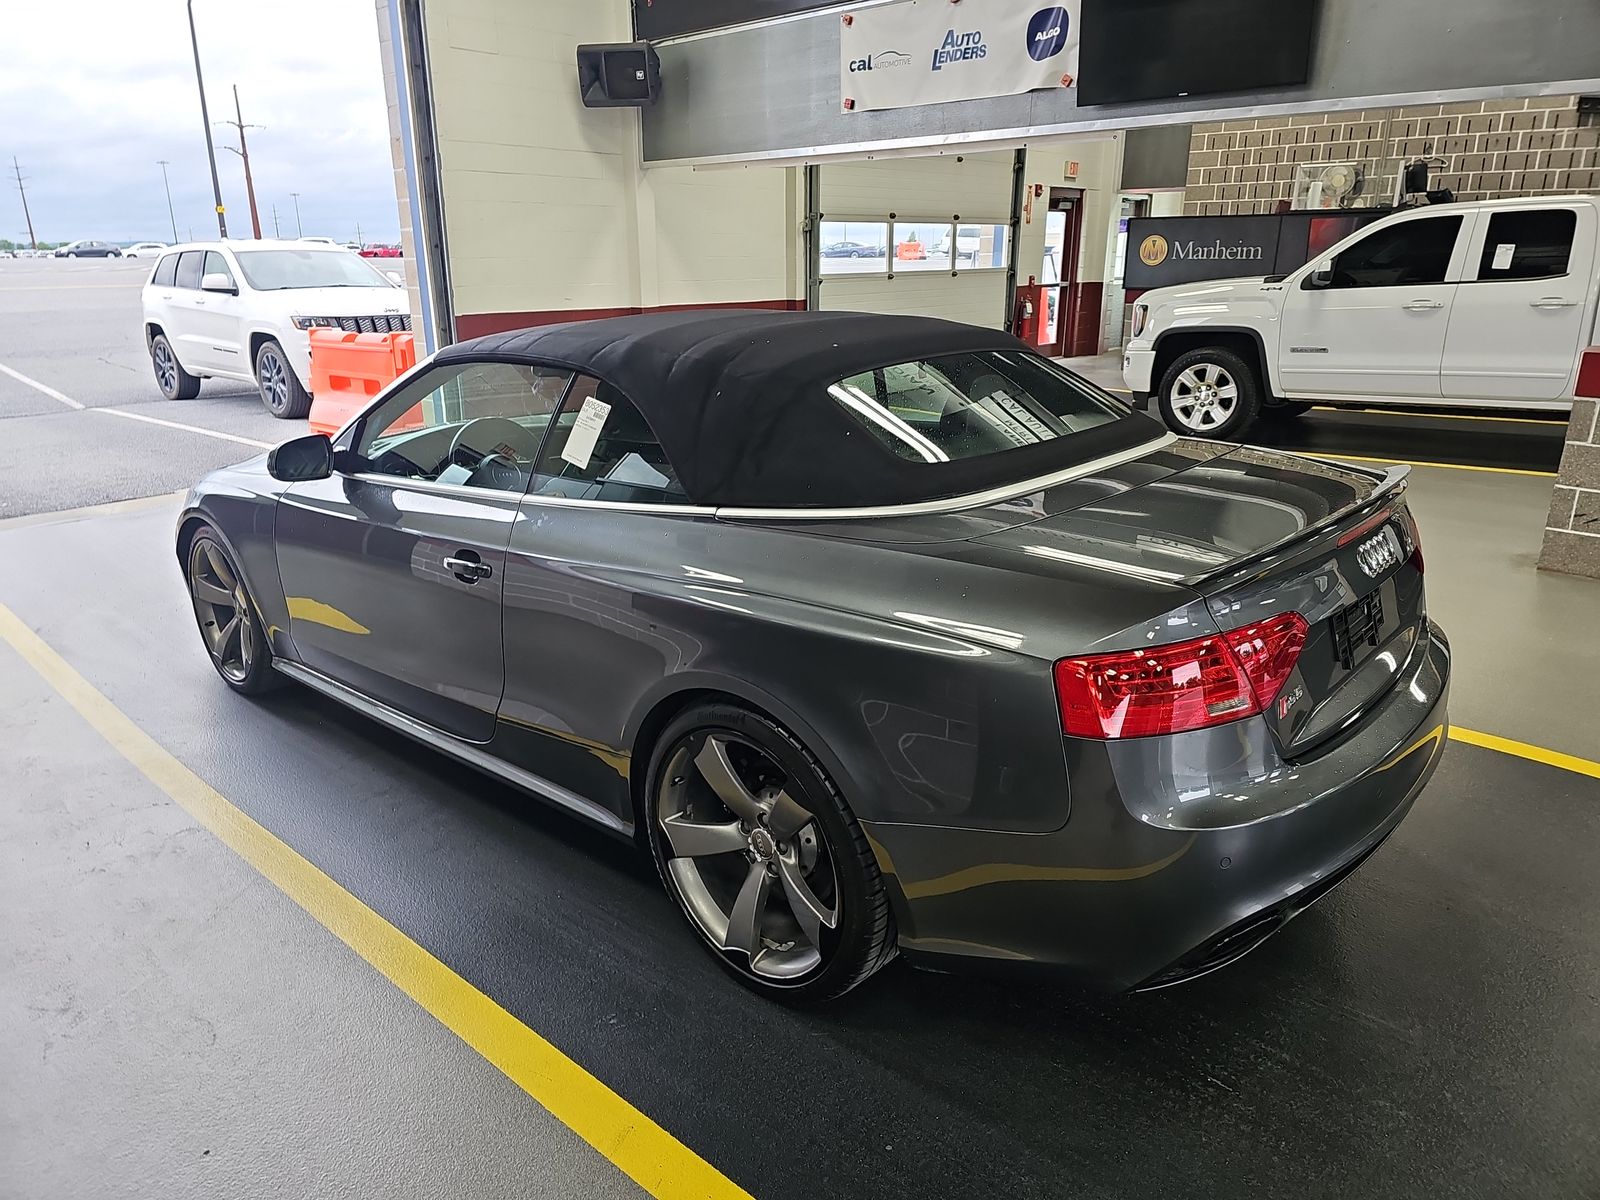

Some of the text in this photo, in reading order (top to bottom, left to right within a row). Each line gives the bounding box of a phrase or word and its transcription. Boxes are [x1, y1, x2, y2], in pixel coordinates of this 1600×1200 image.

[941, 29, 982, 50] AUTO
[1035, 27, 1060, 41] ALGO
[849, 54, 911, 72] cal AUTOMOTIVE
[931, 44, 987, 71] LENDERS
[1171, 240, 1263, 260] Manheim
